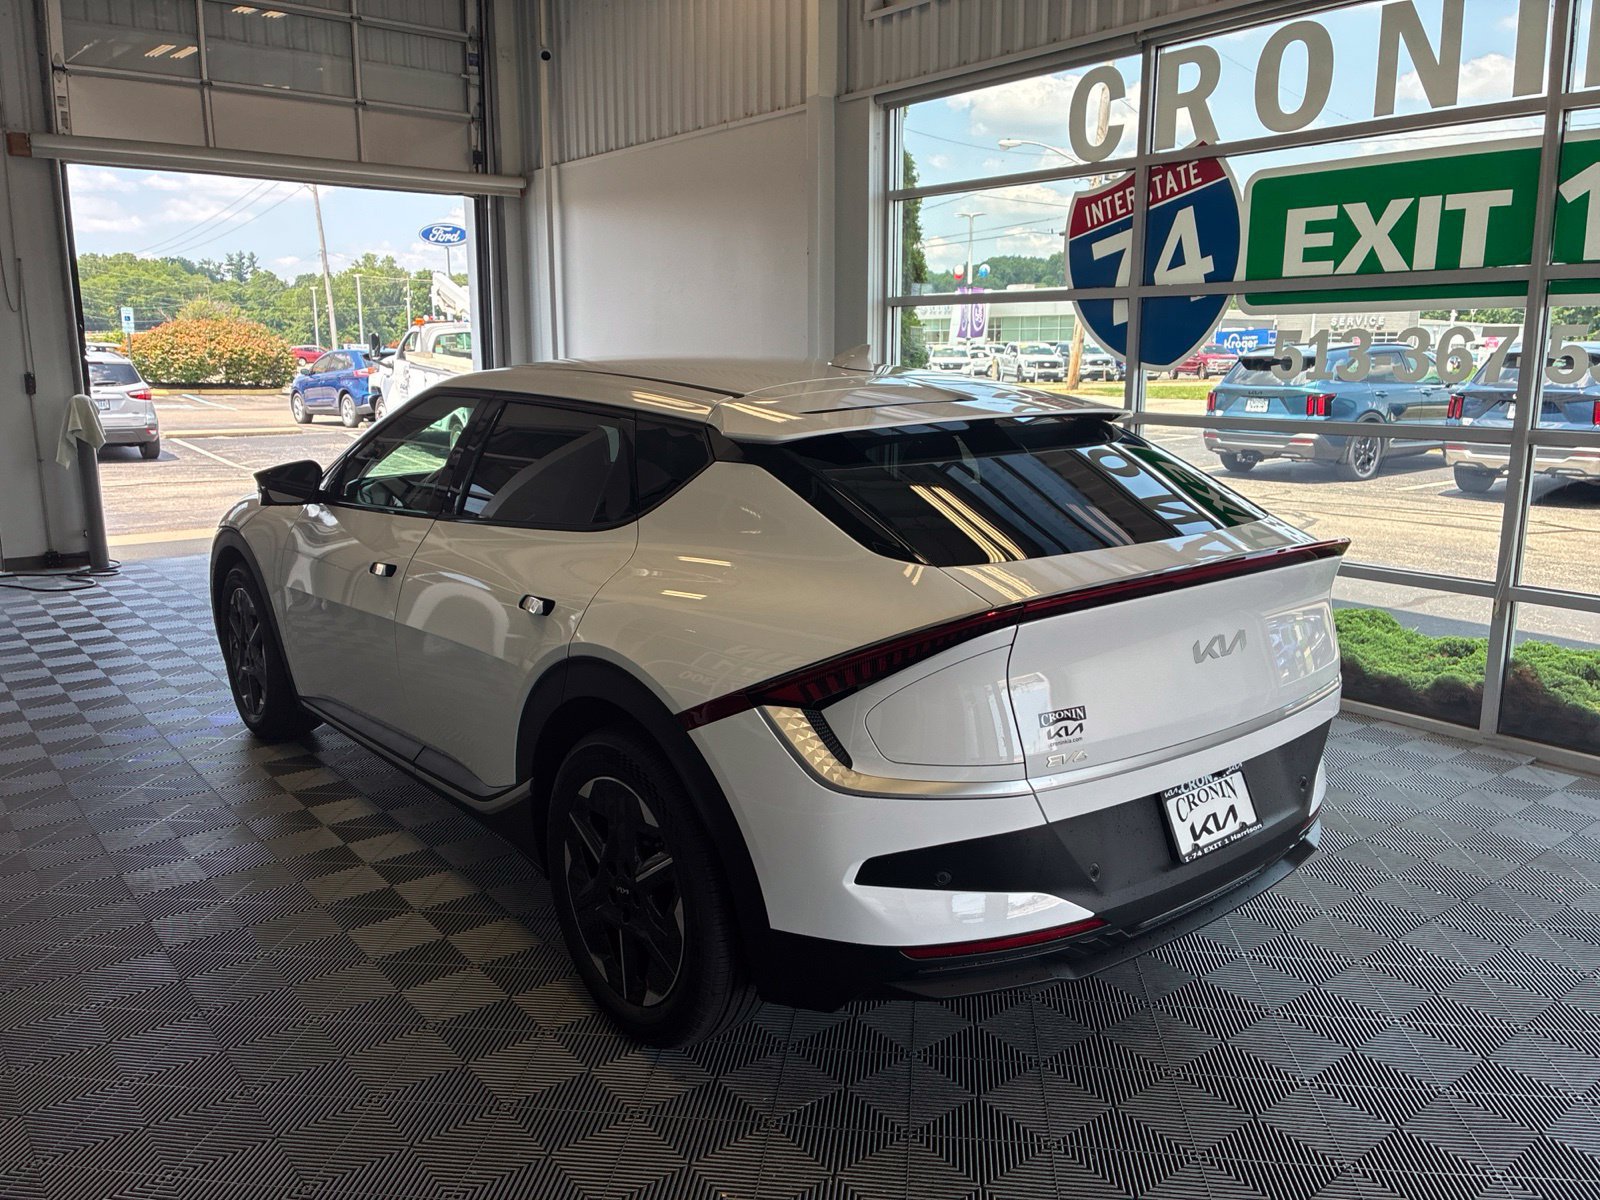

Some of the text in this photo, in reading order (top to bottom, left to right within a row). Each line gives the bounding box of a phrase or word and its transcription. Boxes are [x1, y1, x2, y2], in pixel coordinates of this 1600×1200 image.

[1068, 0, 1600, 163] CRONI
[1085, 161, 1202, 228] INTERTATE
[429, 226, 461, 242] Ford
[1282, 189, 1514, 278] EXIT
[1092, 205, 1215, 326] 74
[1330, 315, 1386, 327] SERVICE
[1223, 333, 1259, 356] Kroger
[1192, 629, 1247, 664] KIA
[1041, 707, 1085, 727] CRONIN
[1047, 722, 1084, 740] KIA
[1176, 777, 1239, 822] CRONIN
[1190, 804, 1238, 842] KIA
[1185, 850, 1203, 862] I-74
[1203, 841, 1222, 853] EXIT
[1230, 824, 1263, 842] Harrison
